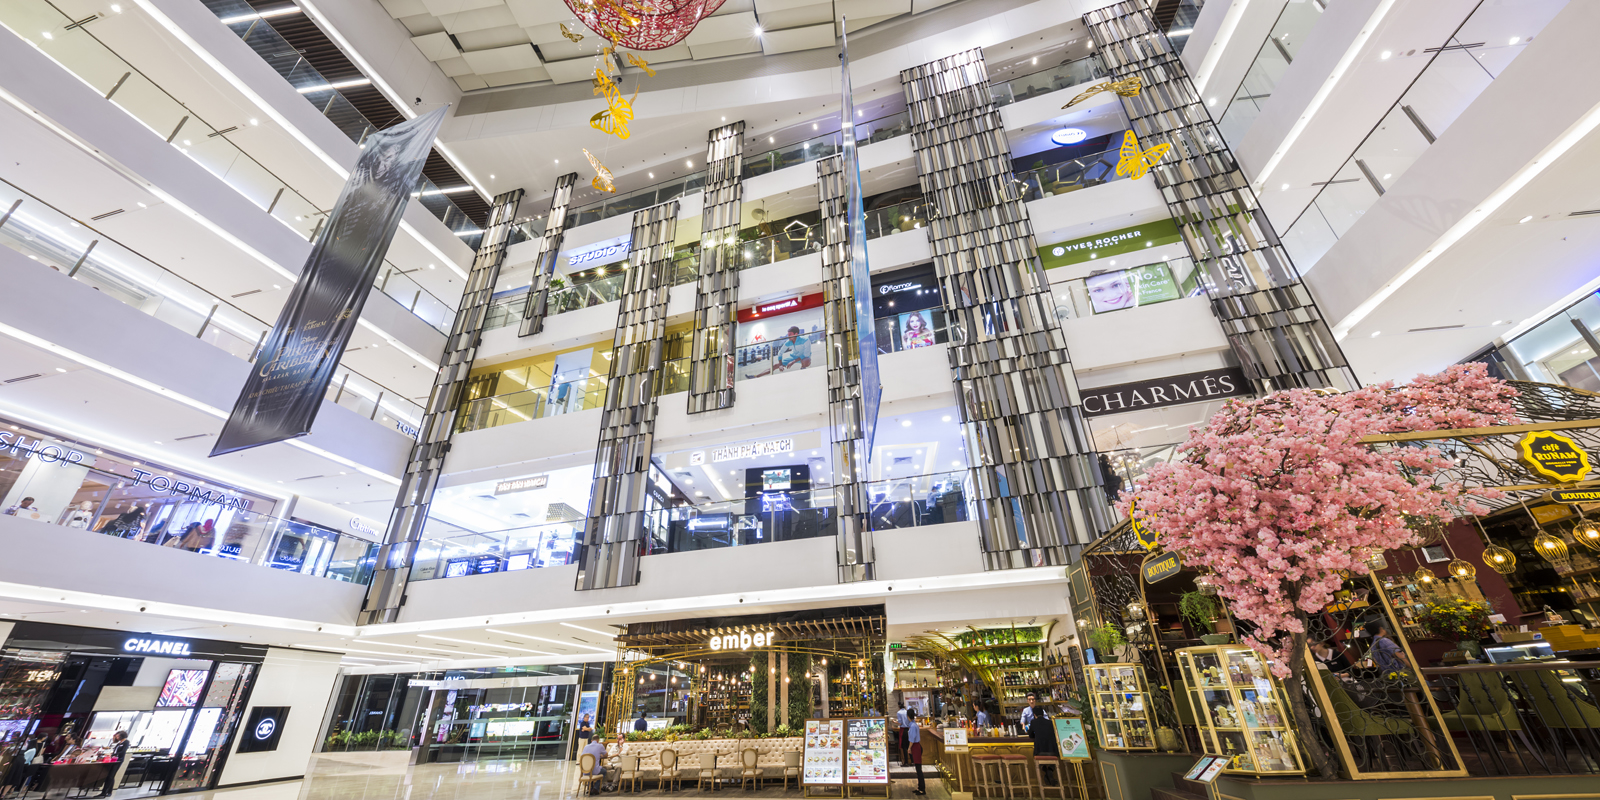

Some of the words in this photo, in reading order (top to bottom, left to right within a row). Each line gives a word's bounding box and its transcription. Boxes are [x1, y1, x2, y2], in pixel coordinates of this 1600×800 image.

[1066, 240, 1093, 252] YVES
[1096, 230, 1142, 246] ROCHER
[569, 246, 618, 266] STUDIO
[621, 242, 630, 252] 7
[1129, 267, 1165, 284] No.1
[1083, 375, 1236, 413] CHARMÉS
[0, 431, 84, 467] SHOP
[763, 439, 792, 454] WATCH
[131, 468, 250, 514] TOPMAN
[1147, 557, 1176, 578] BOUTIQUE
[124, 638, 191, 656] CHANEL
[710, 631, 774, 650] ember
